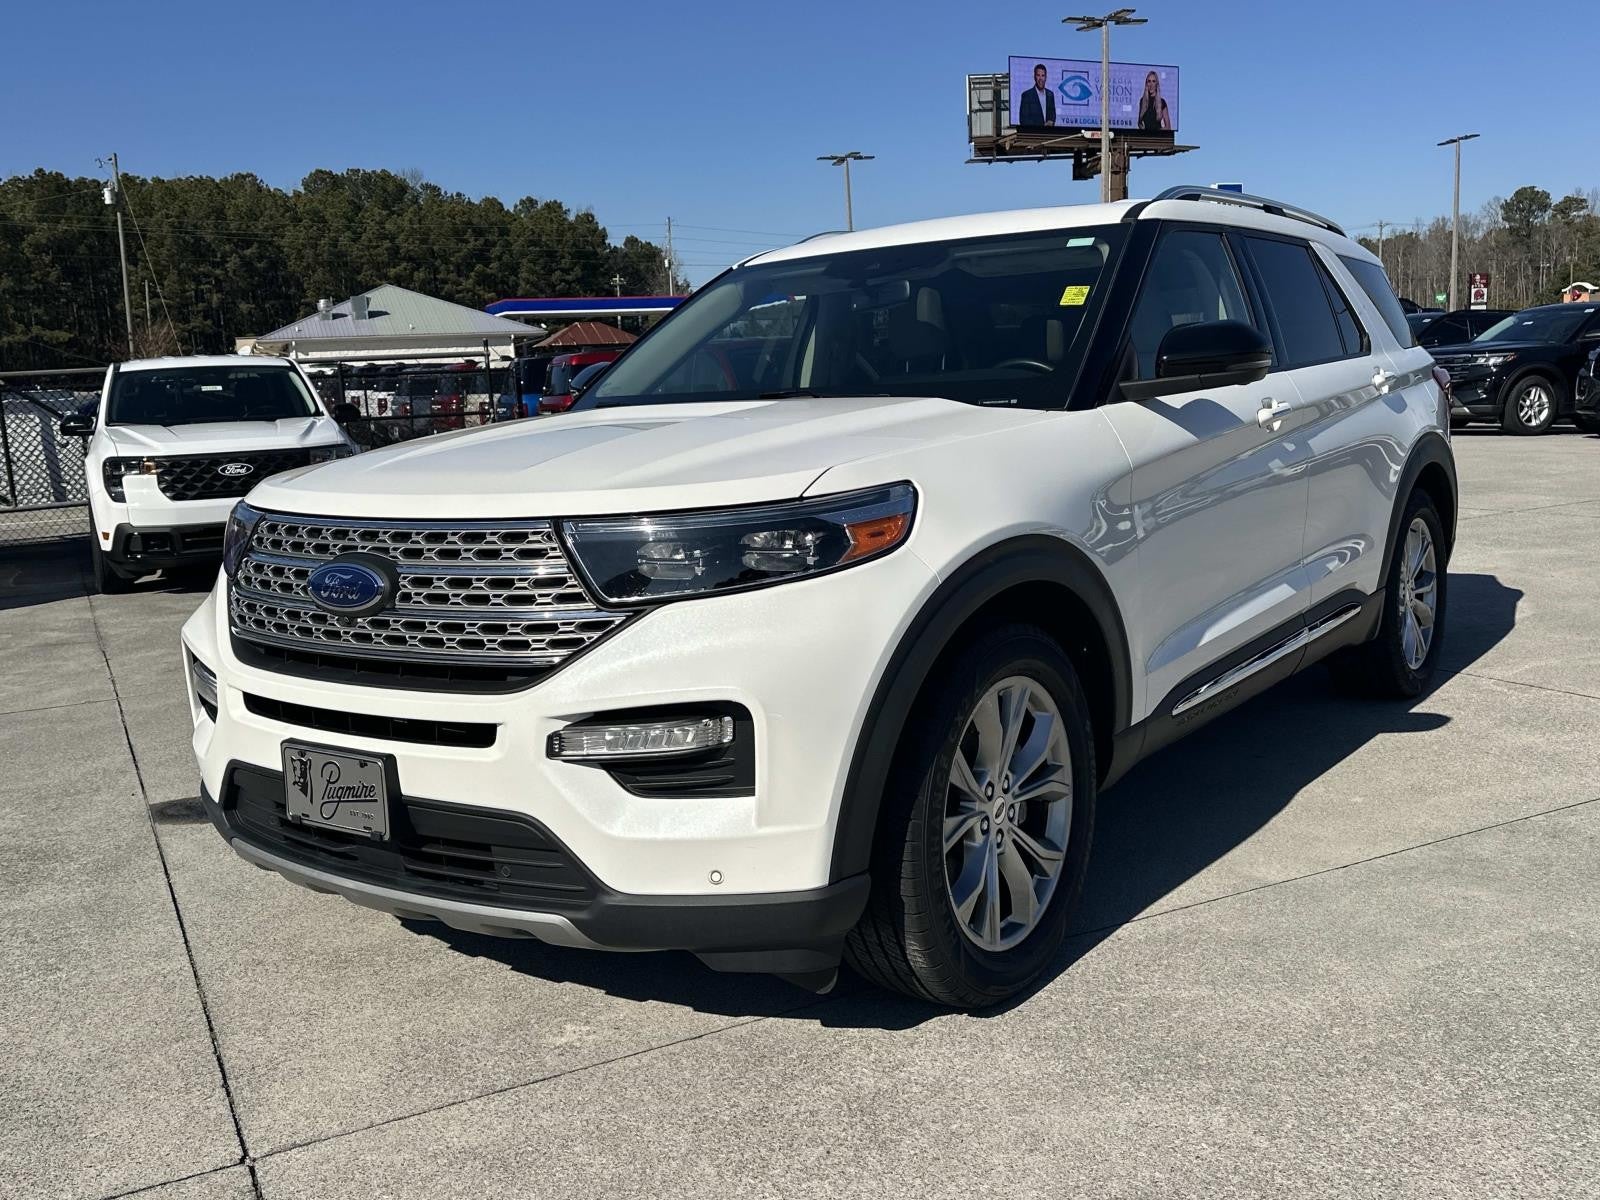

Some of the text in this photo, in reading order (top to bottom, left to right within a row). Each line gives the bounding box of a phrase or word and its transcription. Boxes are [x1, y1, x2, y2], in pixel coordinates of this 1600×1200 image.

[1095, 84, 1132, 96] VSION
[225, 464, 247, 474] Ford
[320, 572, 362, 600] Ford
[320, 760, 378, 820] Pugmire
